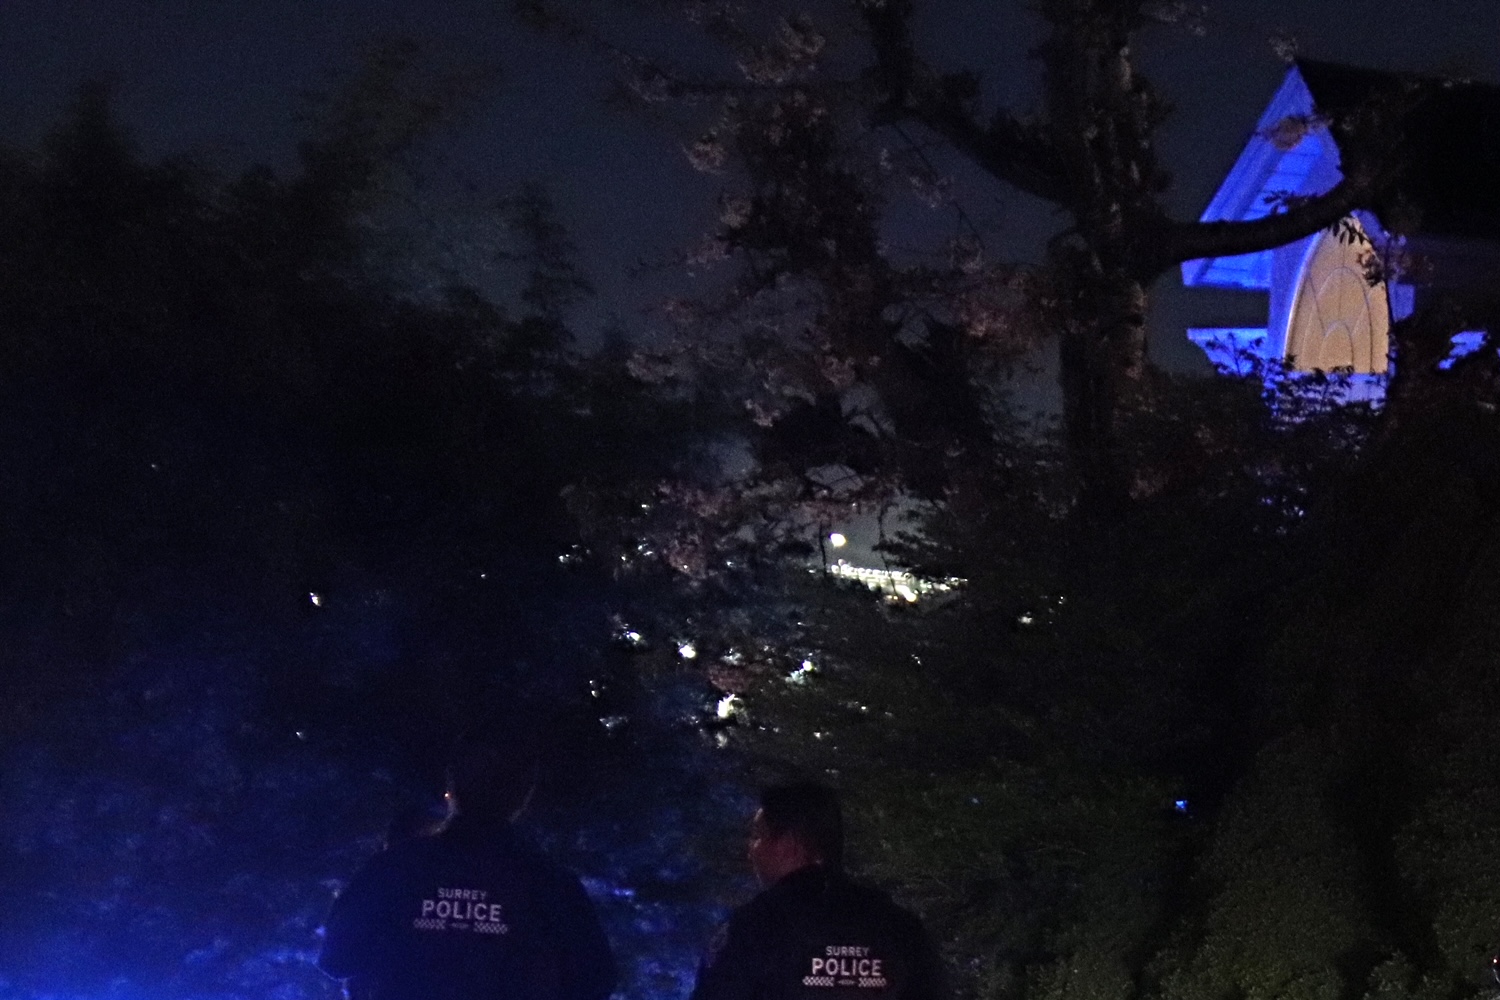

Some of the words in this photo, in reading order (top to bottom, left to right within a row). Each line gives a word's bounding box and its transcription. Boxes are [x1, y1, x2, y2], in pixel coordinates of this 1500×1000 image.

[437, 887, 487, 900] SURREY
[421, 900, 502, 922] POLICE
[825, 945, 870, 957] SURREY
[812, 957, 882, 976] POLICE
